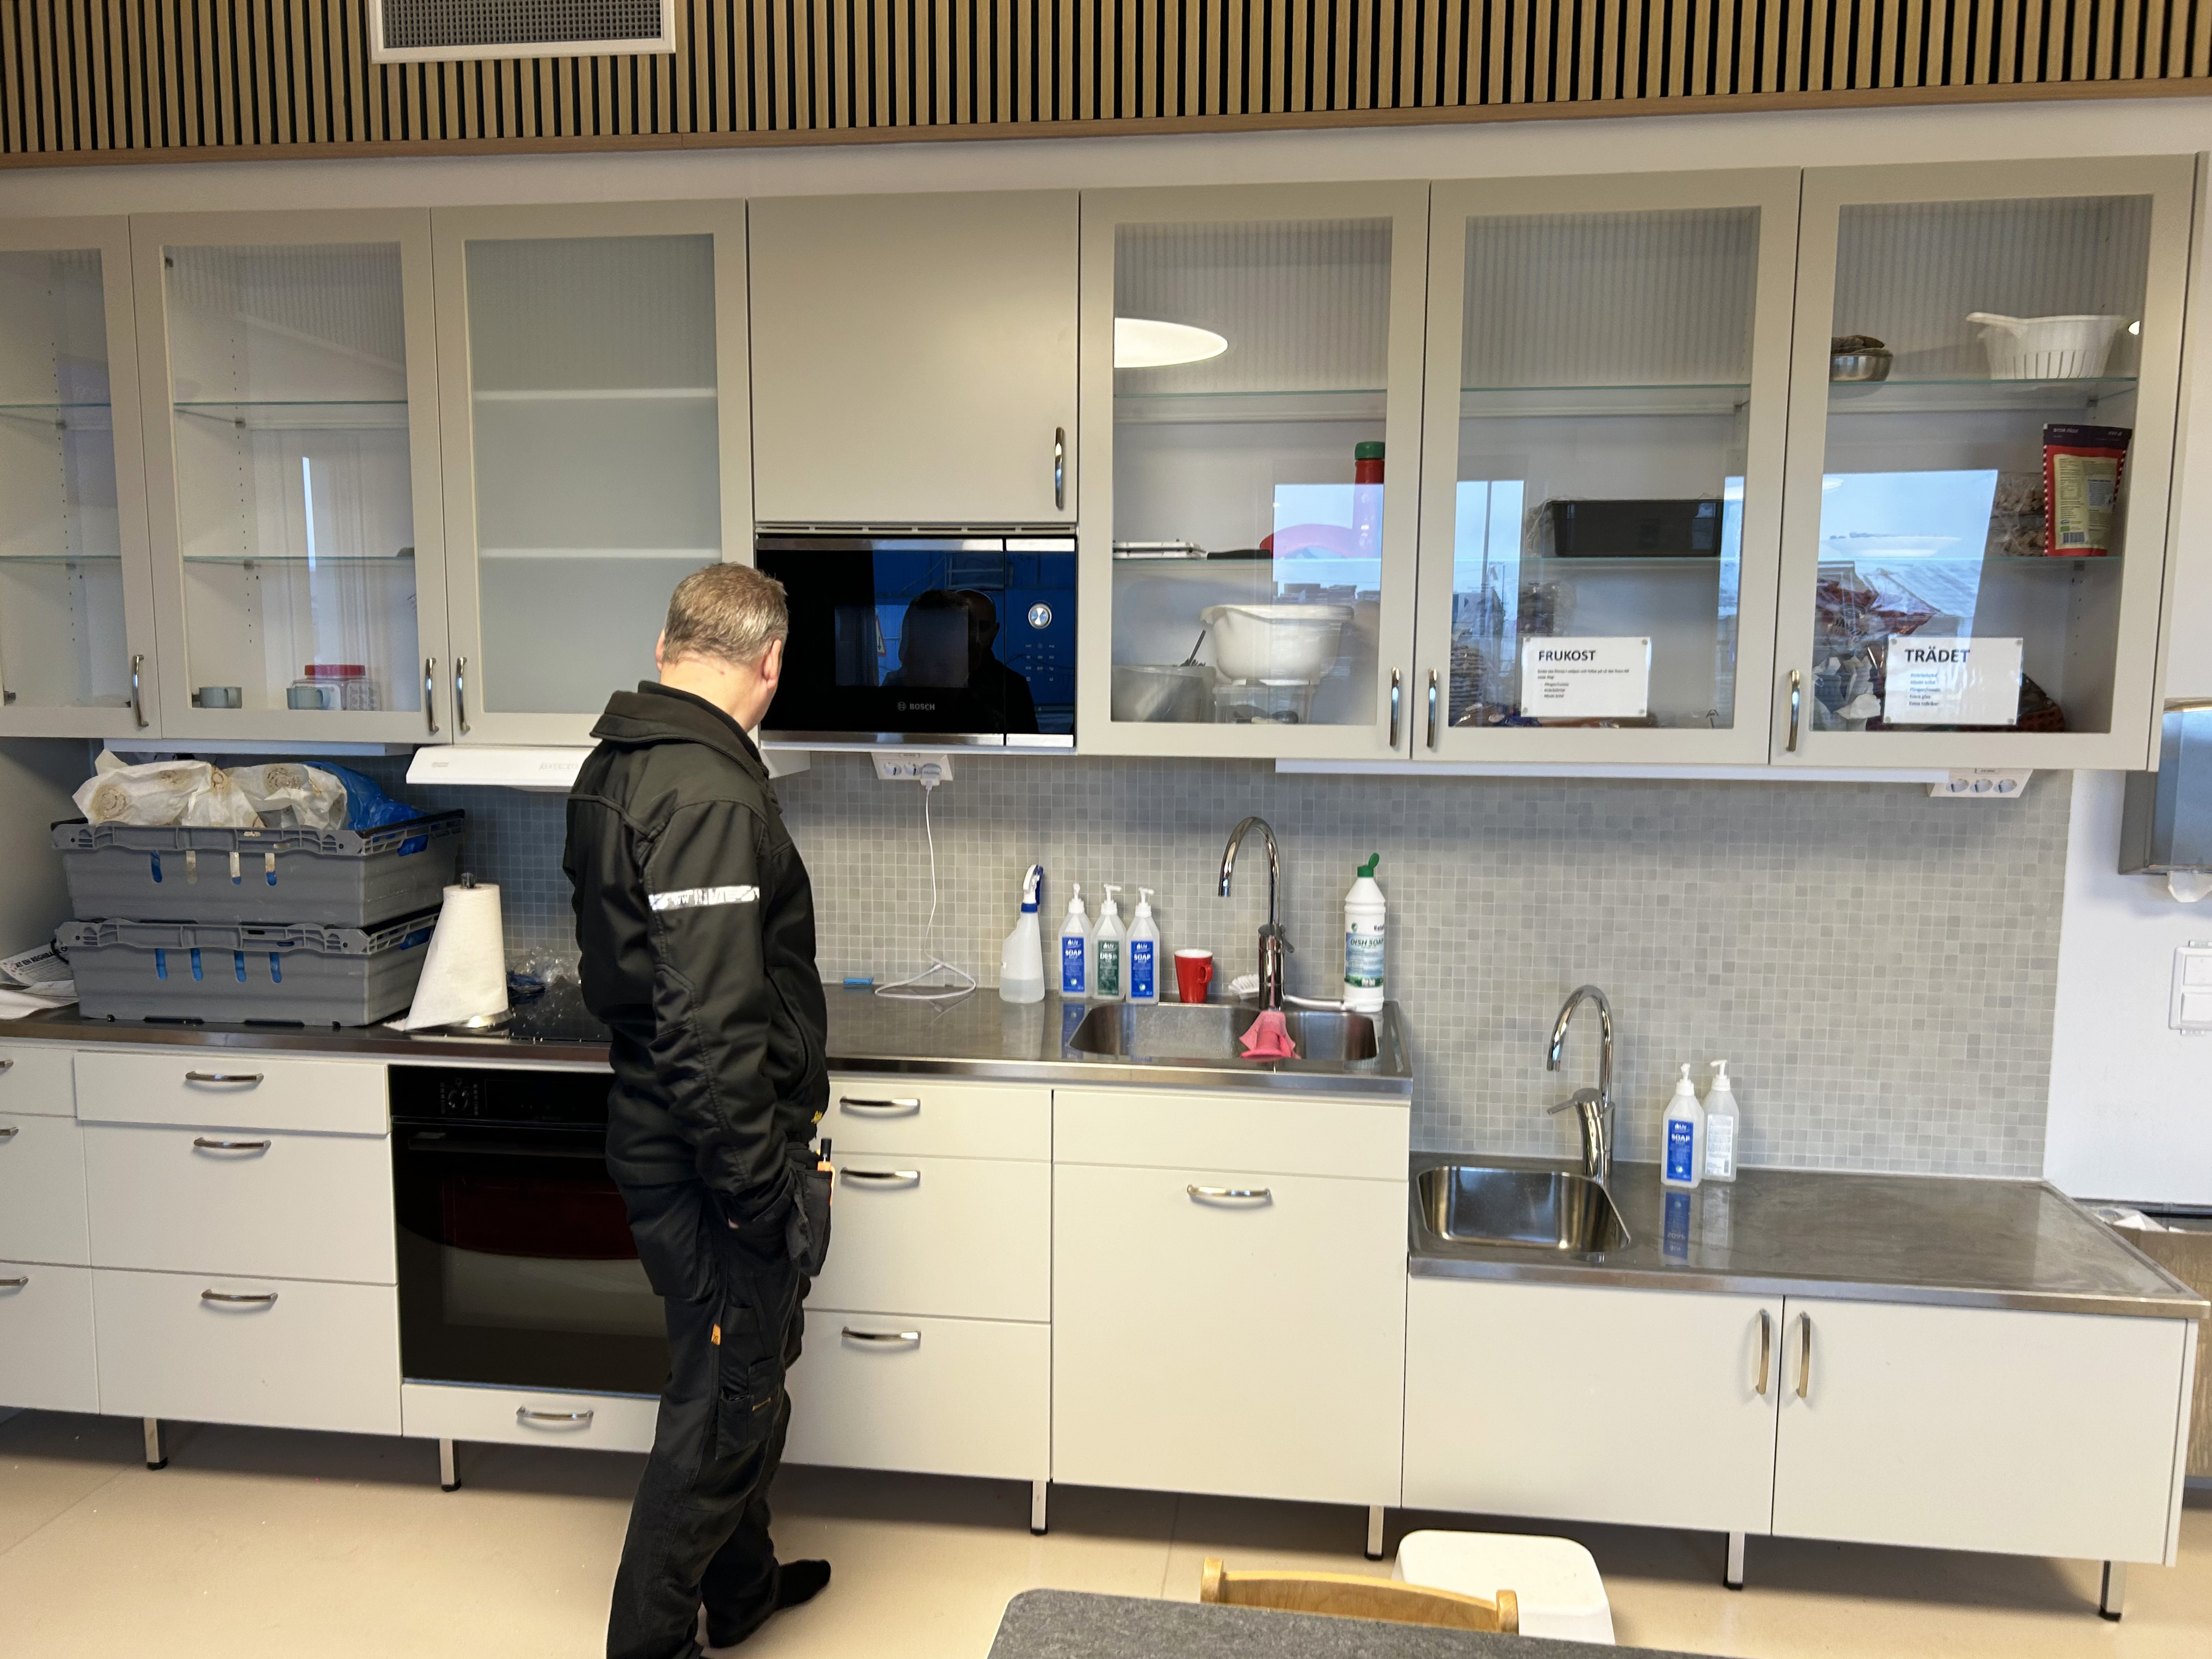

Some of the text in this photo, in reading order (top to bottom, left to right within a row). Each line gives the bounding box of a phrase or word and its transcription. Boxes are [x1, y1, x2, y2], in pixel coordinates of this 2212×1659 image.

[1538, 650, 1596, 661] FRUKOST
[1904, 646, 1970, 663] TRÄDET
[1671, 1134, 1690, 1142] SOAP
